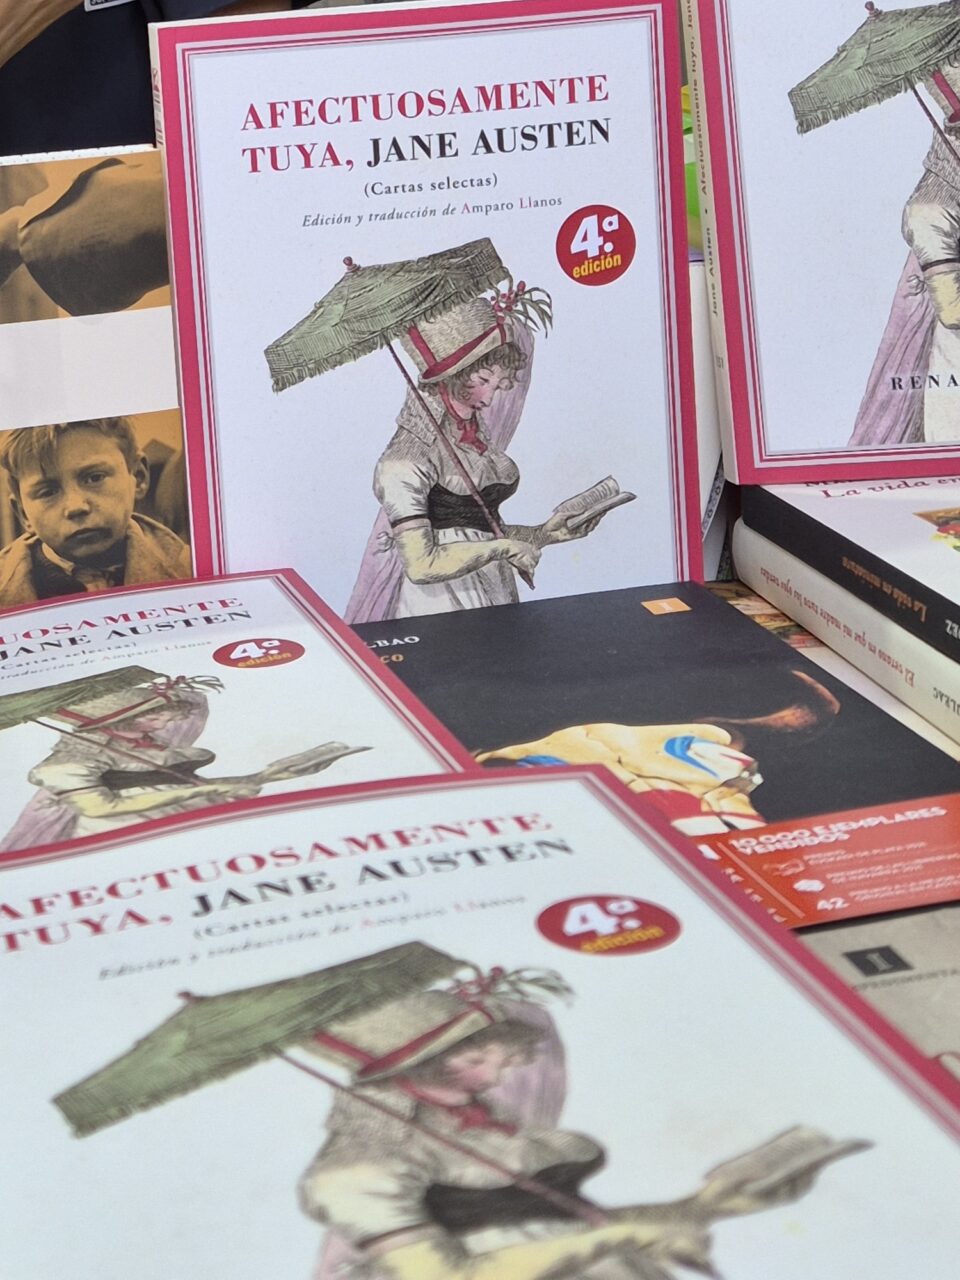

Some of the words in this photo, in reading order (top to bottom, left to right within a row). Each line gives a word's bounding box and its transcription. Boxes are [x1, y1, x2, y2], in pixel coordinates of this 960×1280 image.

[241, 74, 610, 131] AFECTUOSAMENTE
[242, 141, 354, 173] TUYA,
[367, 132, 459, 168] JANE
[472, 118, 612, 156] AUSTEN
[364, 180, 424, 198] (Cartas
[430, 173, 498, 192] selectas)
[302, 211, 352, 228] Edición
[355, 215, 364, 227] y
[368, 206, 437, 223] traducción
[441, 202, 457, 216] de
[461, 198, 514, 217] Amparo
[519, 194, 563, 208] Llanos
[572, 253, 622, 280] edición
[890, 373, 960, 391] RENA
[868, 479, 930, 492] vida
[760, 567, 780, 587] verdes
[892, 588, 912, 609] vida
[819, 608, 842, 631] madre
[911, 600, 928, 622] La
[106, 609, 253, 640] AUSTEN
[238, 650, 293, 668] edición
[878, 650, 904, 674] verano
[904, 669, 915, 688] El
[812, 806, 948, 836] EJEMPLARES
[737, 831, 851, 856] VENDIDOS
[191, 871, 337, 918] JANE
[358, 838, 574, 886] AUSTEN
